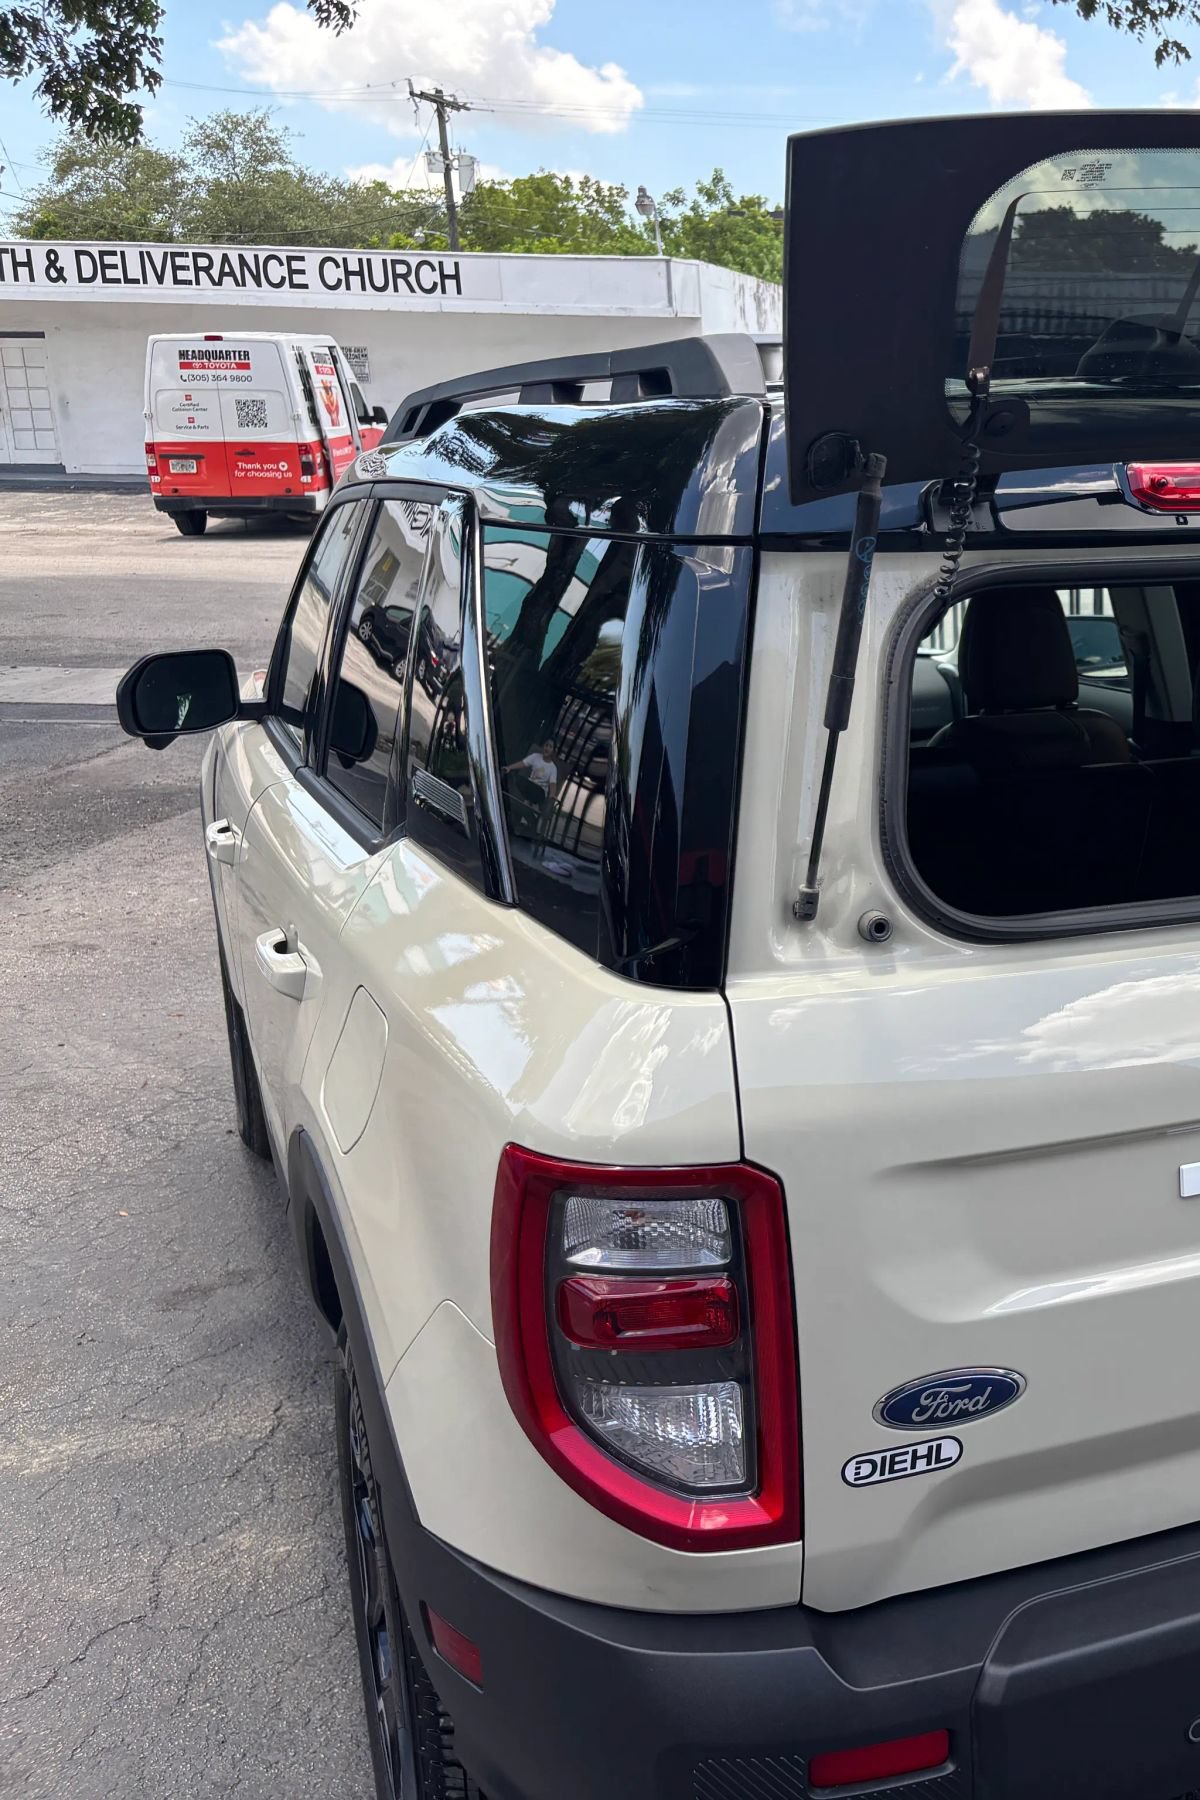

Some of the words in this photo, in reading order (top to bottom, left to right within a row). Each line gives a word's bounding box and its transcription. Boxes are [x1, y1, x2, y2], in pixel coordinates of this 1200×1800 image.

[44, 248, 68, 284] &
[74, 249, 310, 290] DELIVERANCE
[317, 256, 462, 296] CHURCH
[178, 350, 250, 361] HEADQUARTER
[187, 374, 210, 383] (305)
[210, 374, 228, 383] 364
[229, 374, 253, 383] 9800
[237, 462, 262, 470] Thank
[234, 470, 246, 478] for
[246, 471, 283, 480] choosing
[911, 1383, 992, 1422] Ford
[853, 1442, 953, 1482] DIEHL
